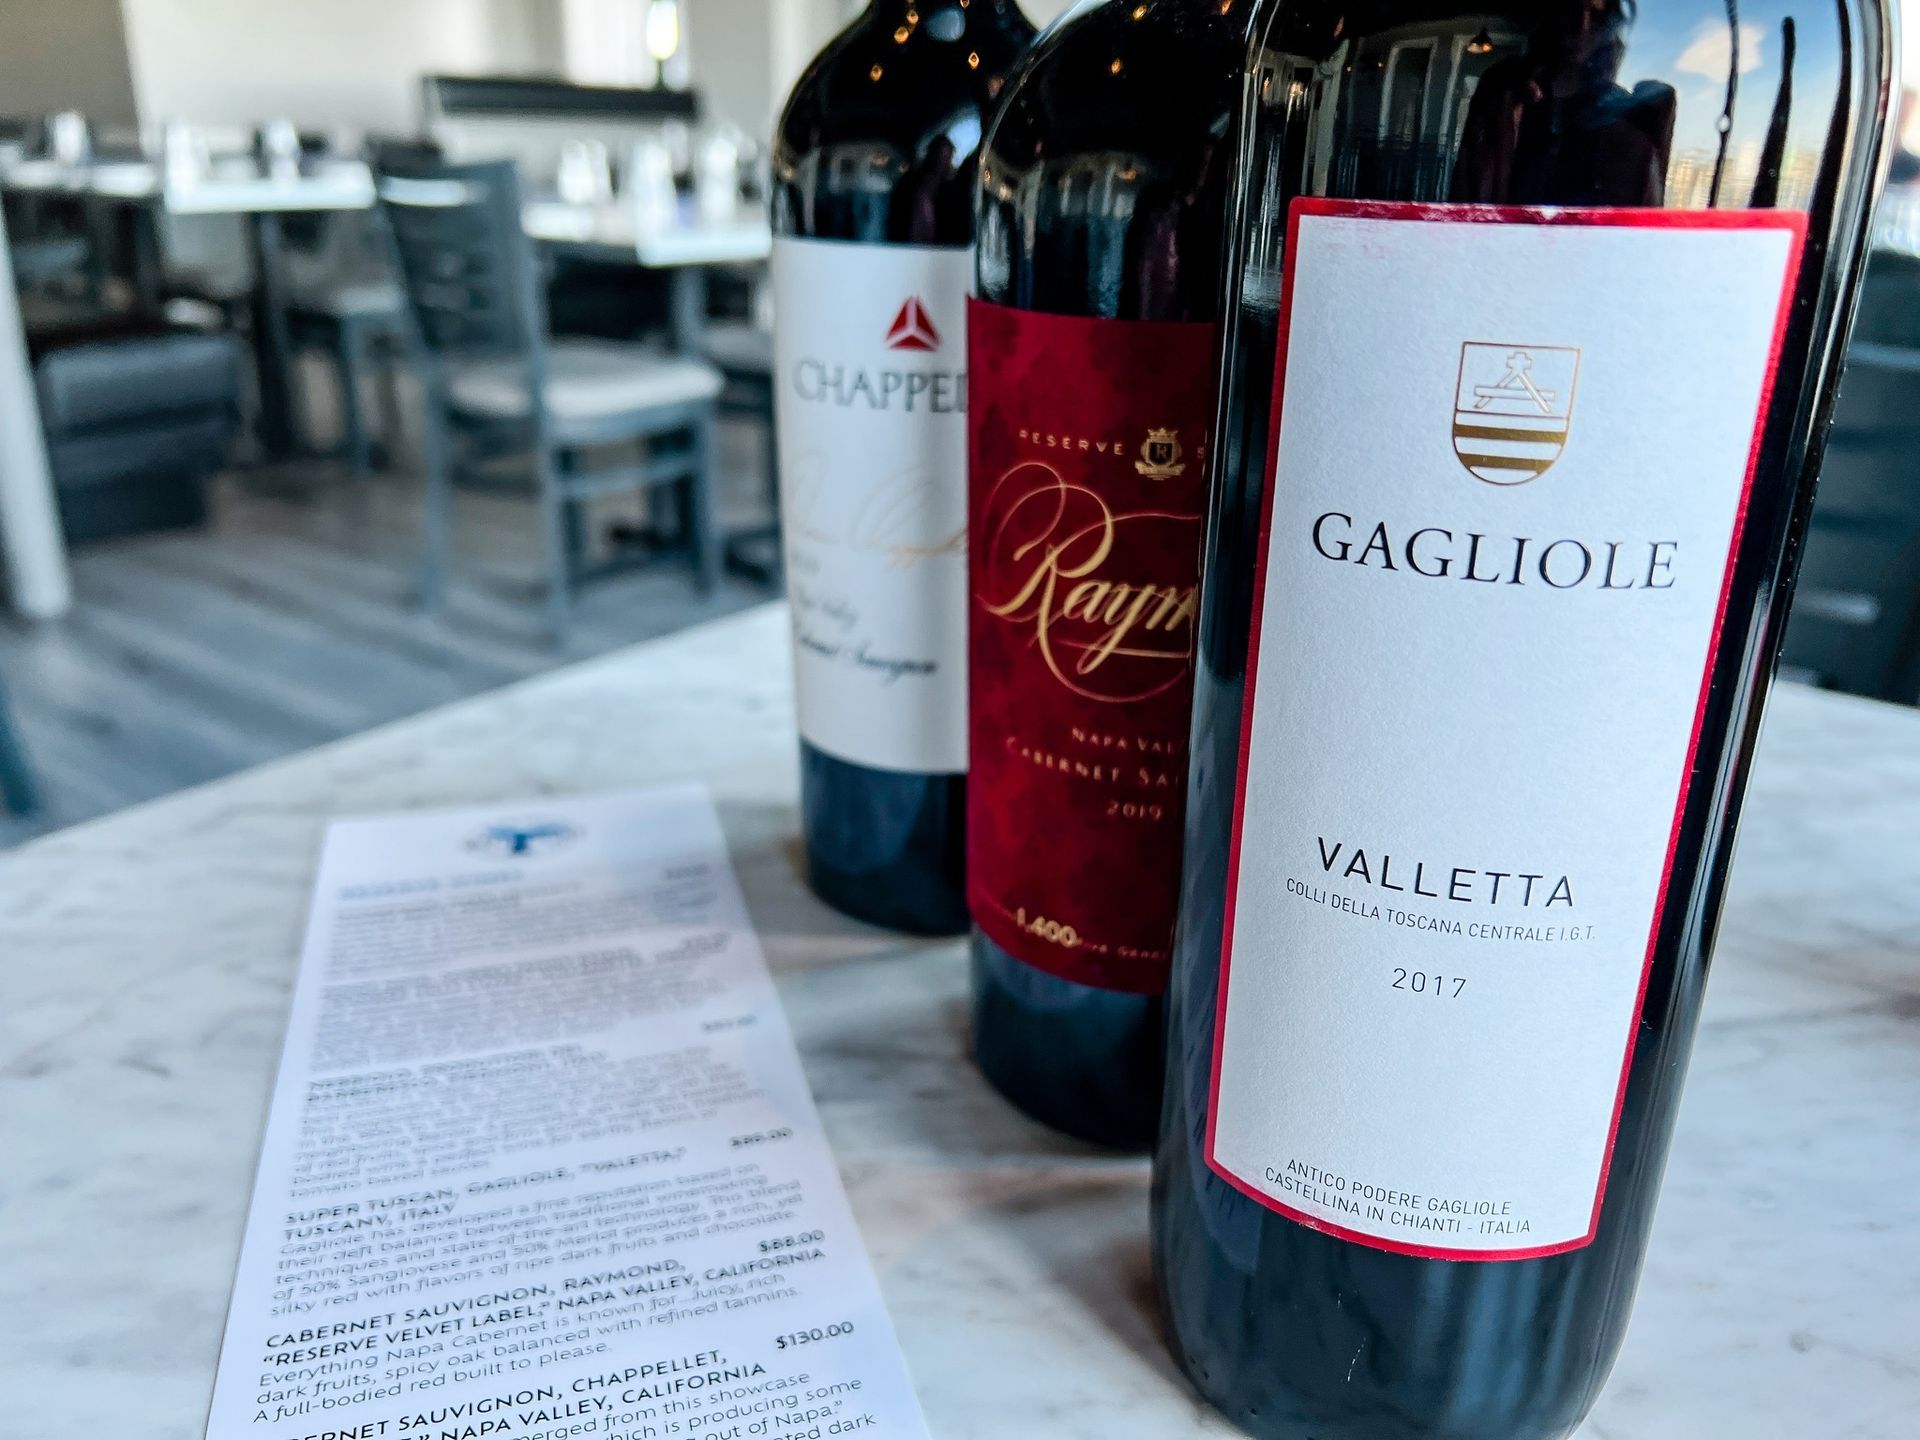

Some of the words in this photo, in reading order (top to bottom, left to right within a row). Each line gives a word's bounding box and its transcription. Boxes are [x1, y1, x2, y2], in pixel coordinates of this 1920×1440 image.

[1019, 429, 1124, 456] RESERVE
[1312, 512, 1678, 590] GAGLIOLE
[1006, 736, 1120, 782] CABERNET
[1071, 727, 1128, 750] NAPA
[1106, 801, 1162, 820] 2019
[1317, 836, 1574, 908] VALLETTA
[1286, 877, 1327, 905] COLLI
[1331, 893, 1381, 921] DELLA
[1386, 908, 1463, 936] TOSCANA
[1467, 922, 1555, 942] CENTRALE
[1559, 924, 1596, 941] I.G.T.
[1391, 967, 1468, 998] 2017
[285, 1203, 360, 1224] SUPER
[367, 1186, 459, 1211] TUSCAN,
[401, 1201, 456, 1222] ITALY
[1265, 1167, 1361, 1216] CASTELLINA
[1366, 1205, 1385, 1222] IN
[1390, 1210, 1461, 1233] CHIANTI
[1479, 1219, 1531, 1235] ITALIA
[1287, 1159, 1346, 1191] ANTICO
[1351, 1181, 1422, 1209] PODERE
[1427, 1197, 1512, 1216] GAGLIOLE
[273, 1287, 294, 1301] of
[276, 1256, 389, 1285] techniques
[396, 1247, 436, 1264] and
[266, 1313, 396, 1348] CABERNET
[404, 1283, 556, 1322] SAUVIGNON,
[564, 1258, 687, 1292] RAYMOND,
[270, 1301, 317, 1317] silky
[322, 1291, 359, 1307] red
[362, 1282, 411, 1299] with
[385, 1317, 465, 1345] VELVET
[558, 1284, 618, 1310] NAPA
[621, 1272, 700, 1298] VALLEY,
[705, 1248, 827, 1281] CALIFORNIA
[256, 1384, 307, 1405] dark
[313, 1372, 377, 1398] fruits,
[384, 1358, 440, 1384] spicy
[447, 1348, 486, 1368] oak
[493, 1328, 591, 1357] balanced
[597, 1317, 642, 1336] with
[648, 1301, 719, 1326] refined
[259, 1355, 379, 1388] Everything
[387, 1340, 444, 1362] Napa
[452, 1320, 547, 1349] Cabernet
[556, 1312, 570, 1328] is
[577, 1301, 645, 1322] known
[775, 1320, 855, 1350] $130.00
[252, 1409, 269, 1424] A
[273, 1382, 402, 1423] full-bodied
[409, 1374, 446, 1392] red
[453, 1361, 502, 1383] built
[510, 1357, 532, 1371] to
[399, 1385, 562, 1431] SAUVIGNON,
[571, 1349, 728, 1394] CHAPPELLET,
[441, 1418, 511, 1440] NAPA
[519, 1394, 613, 1426] VALLEY,
[622, 1363, 766, 1404] CALIFORNIA
[513, 1416, 597, 1440] erged
[603, 1408, 657, 1431] from
[662, 1396, 702, 1416] this
[710, 1373, 811, 1405] showcase
[606, 1424, 657, 1440] hich
[664, 1420, 681, 1434] is
[688, 1395, 799, 1432] producing
[806, 1378, 863, 1402] some
[706, 1424, 742, 1440] out
[748, 1416, 768, 1435] of
[828, 1413, 877, 1435] dark
